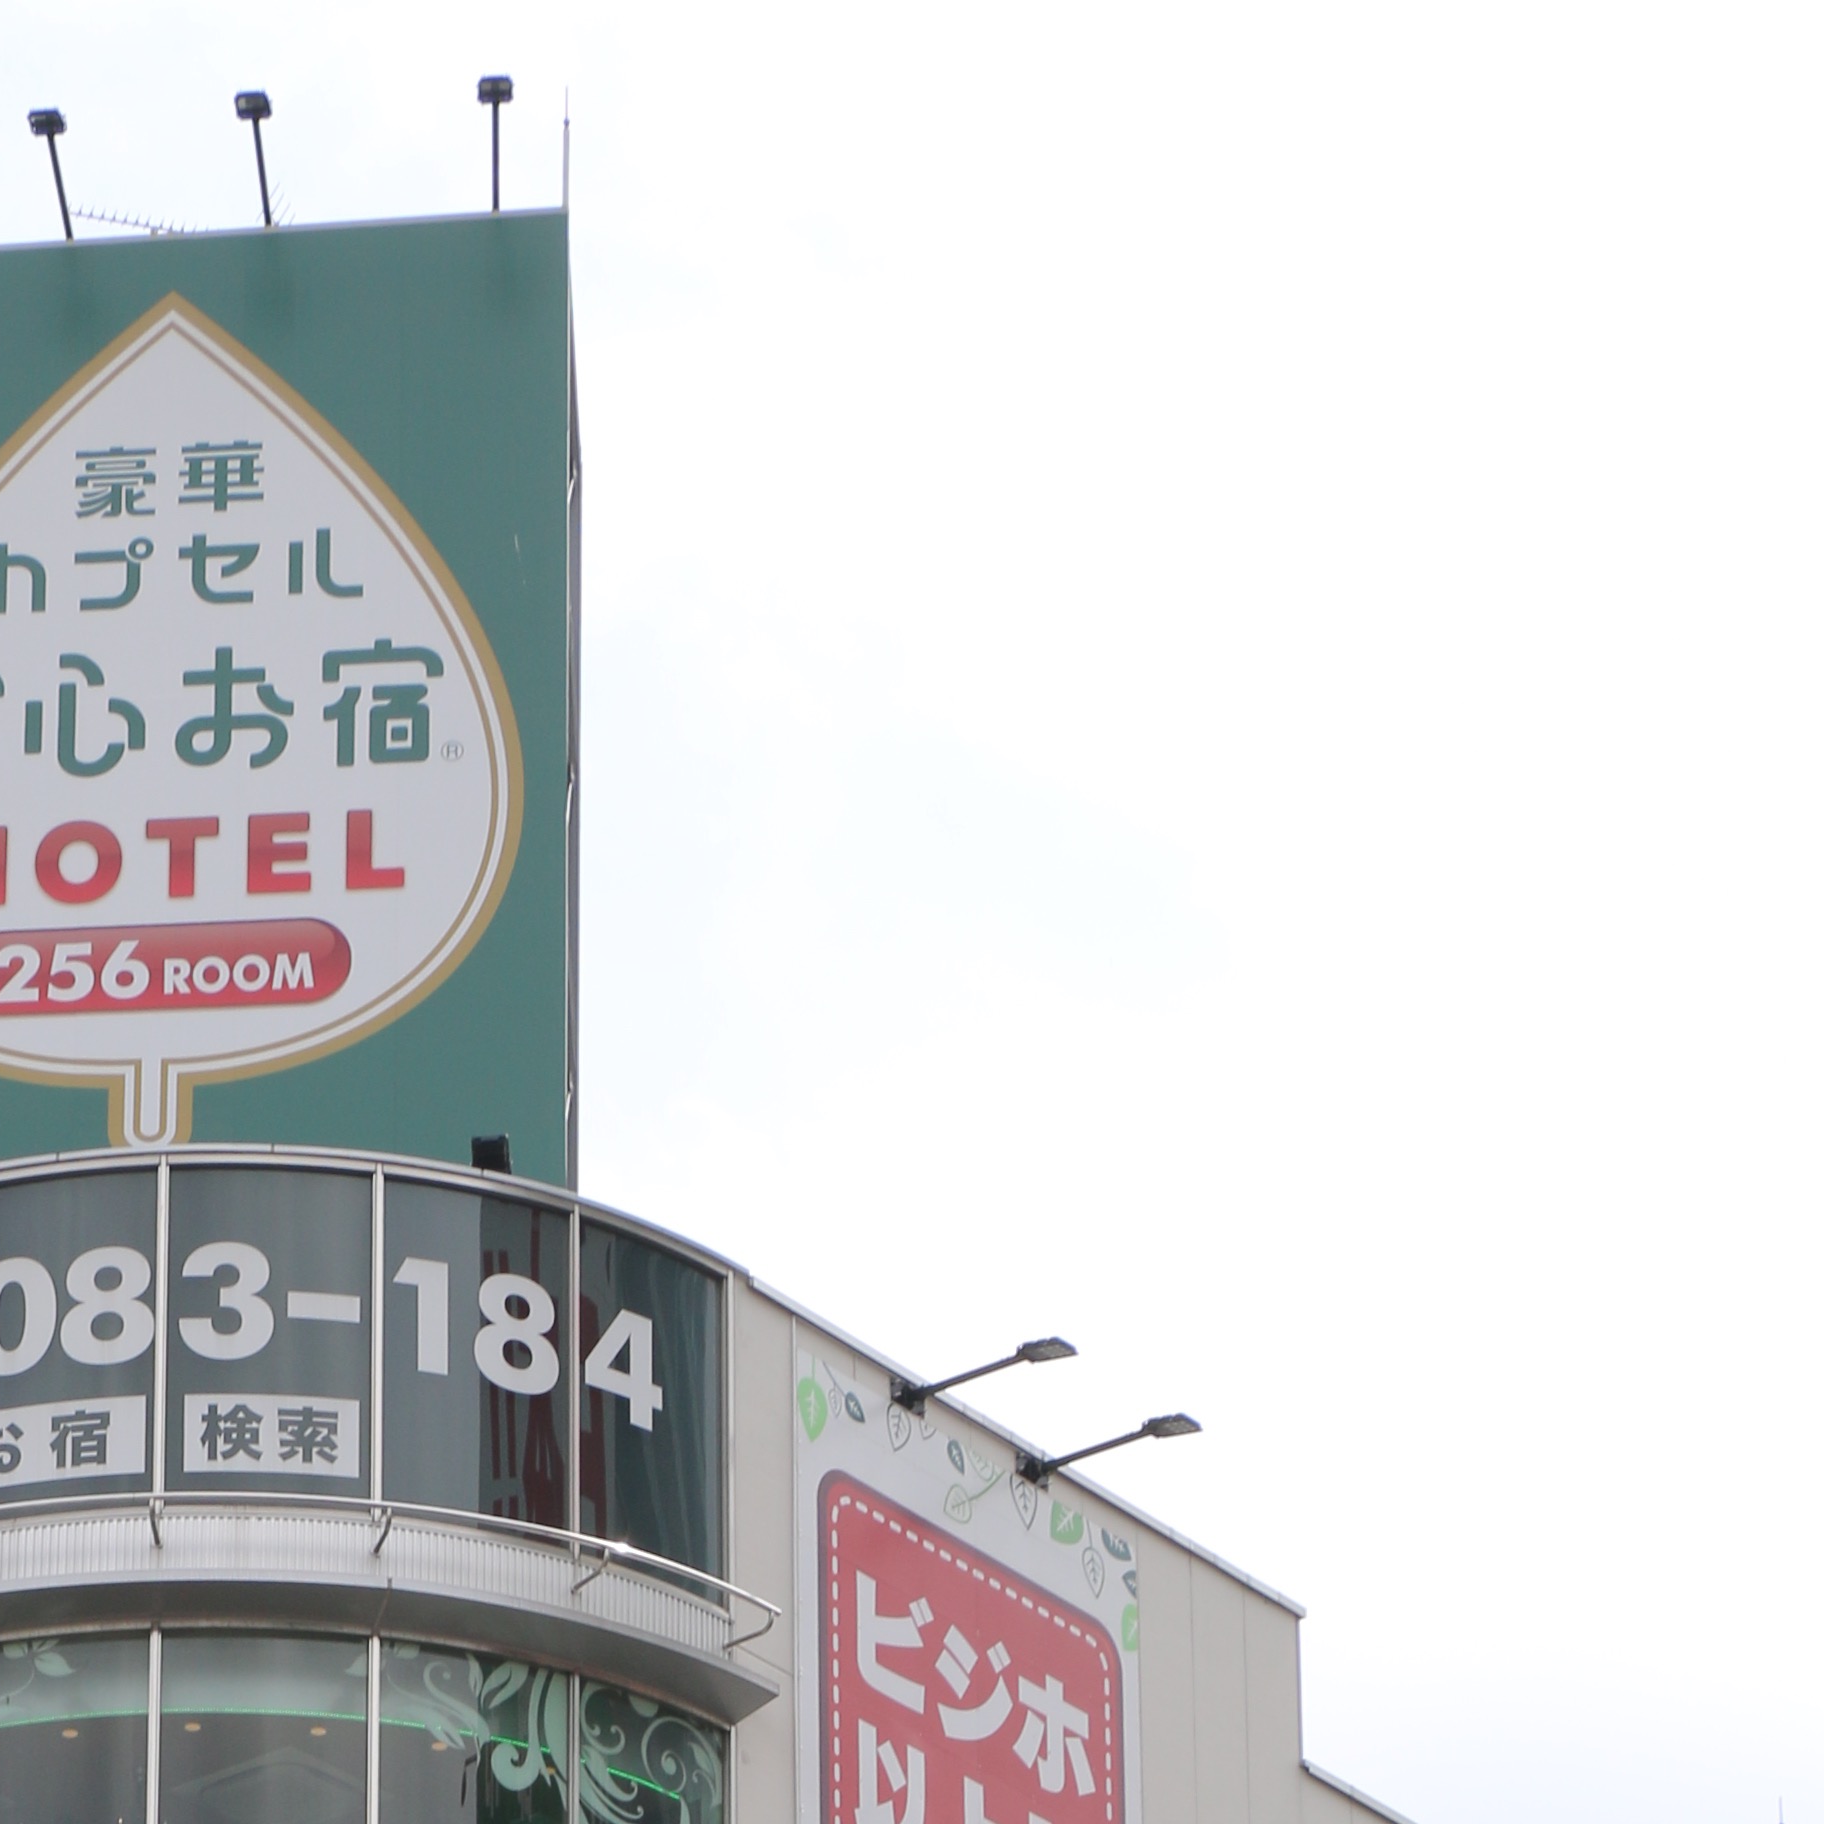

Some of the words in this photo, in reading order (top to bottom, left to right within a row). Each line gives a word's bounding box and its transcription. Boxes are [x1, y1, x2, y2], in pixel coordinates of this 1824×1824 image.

[73, 440, 266, 519] 豪華
[161, 951, 316, 997] ROOM
[199, 1402, 341, 1464] 検索
[853, 1568, 1096, 1799] ビジホ
